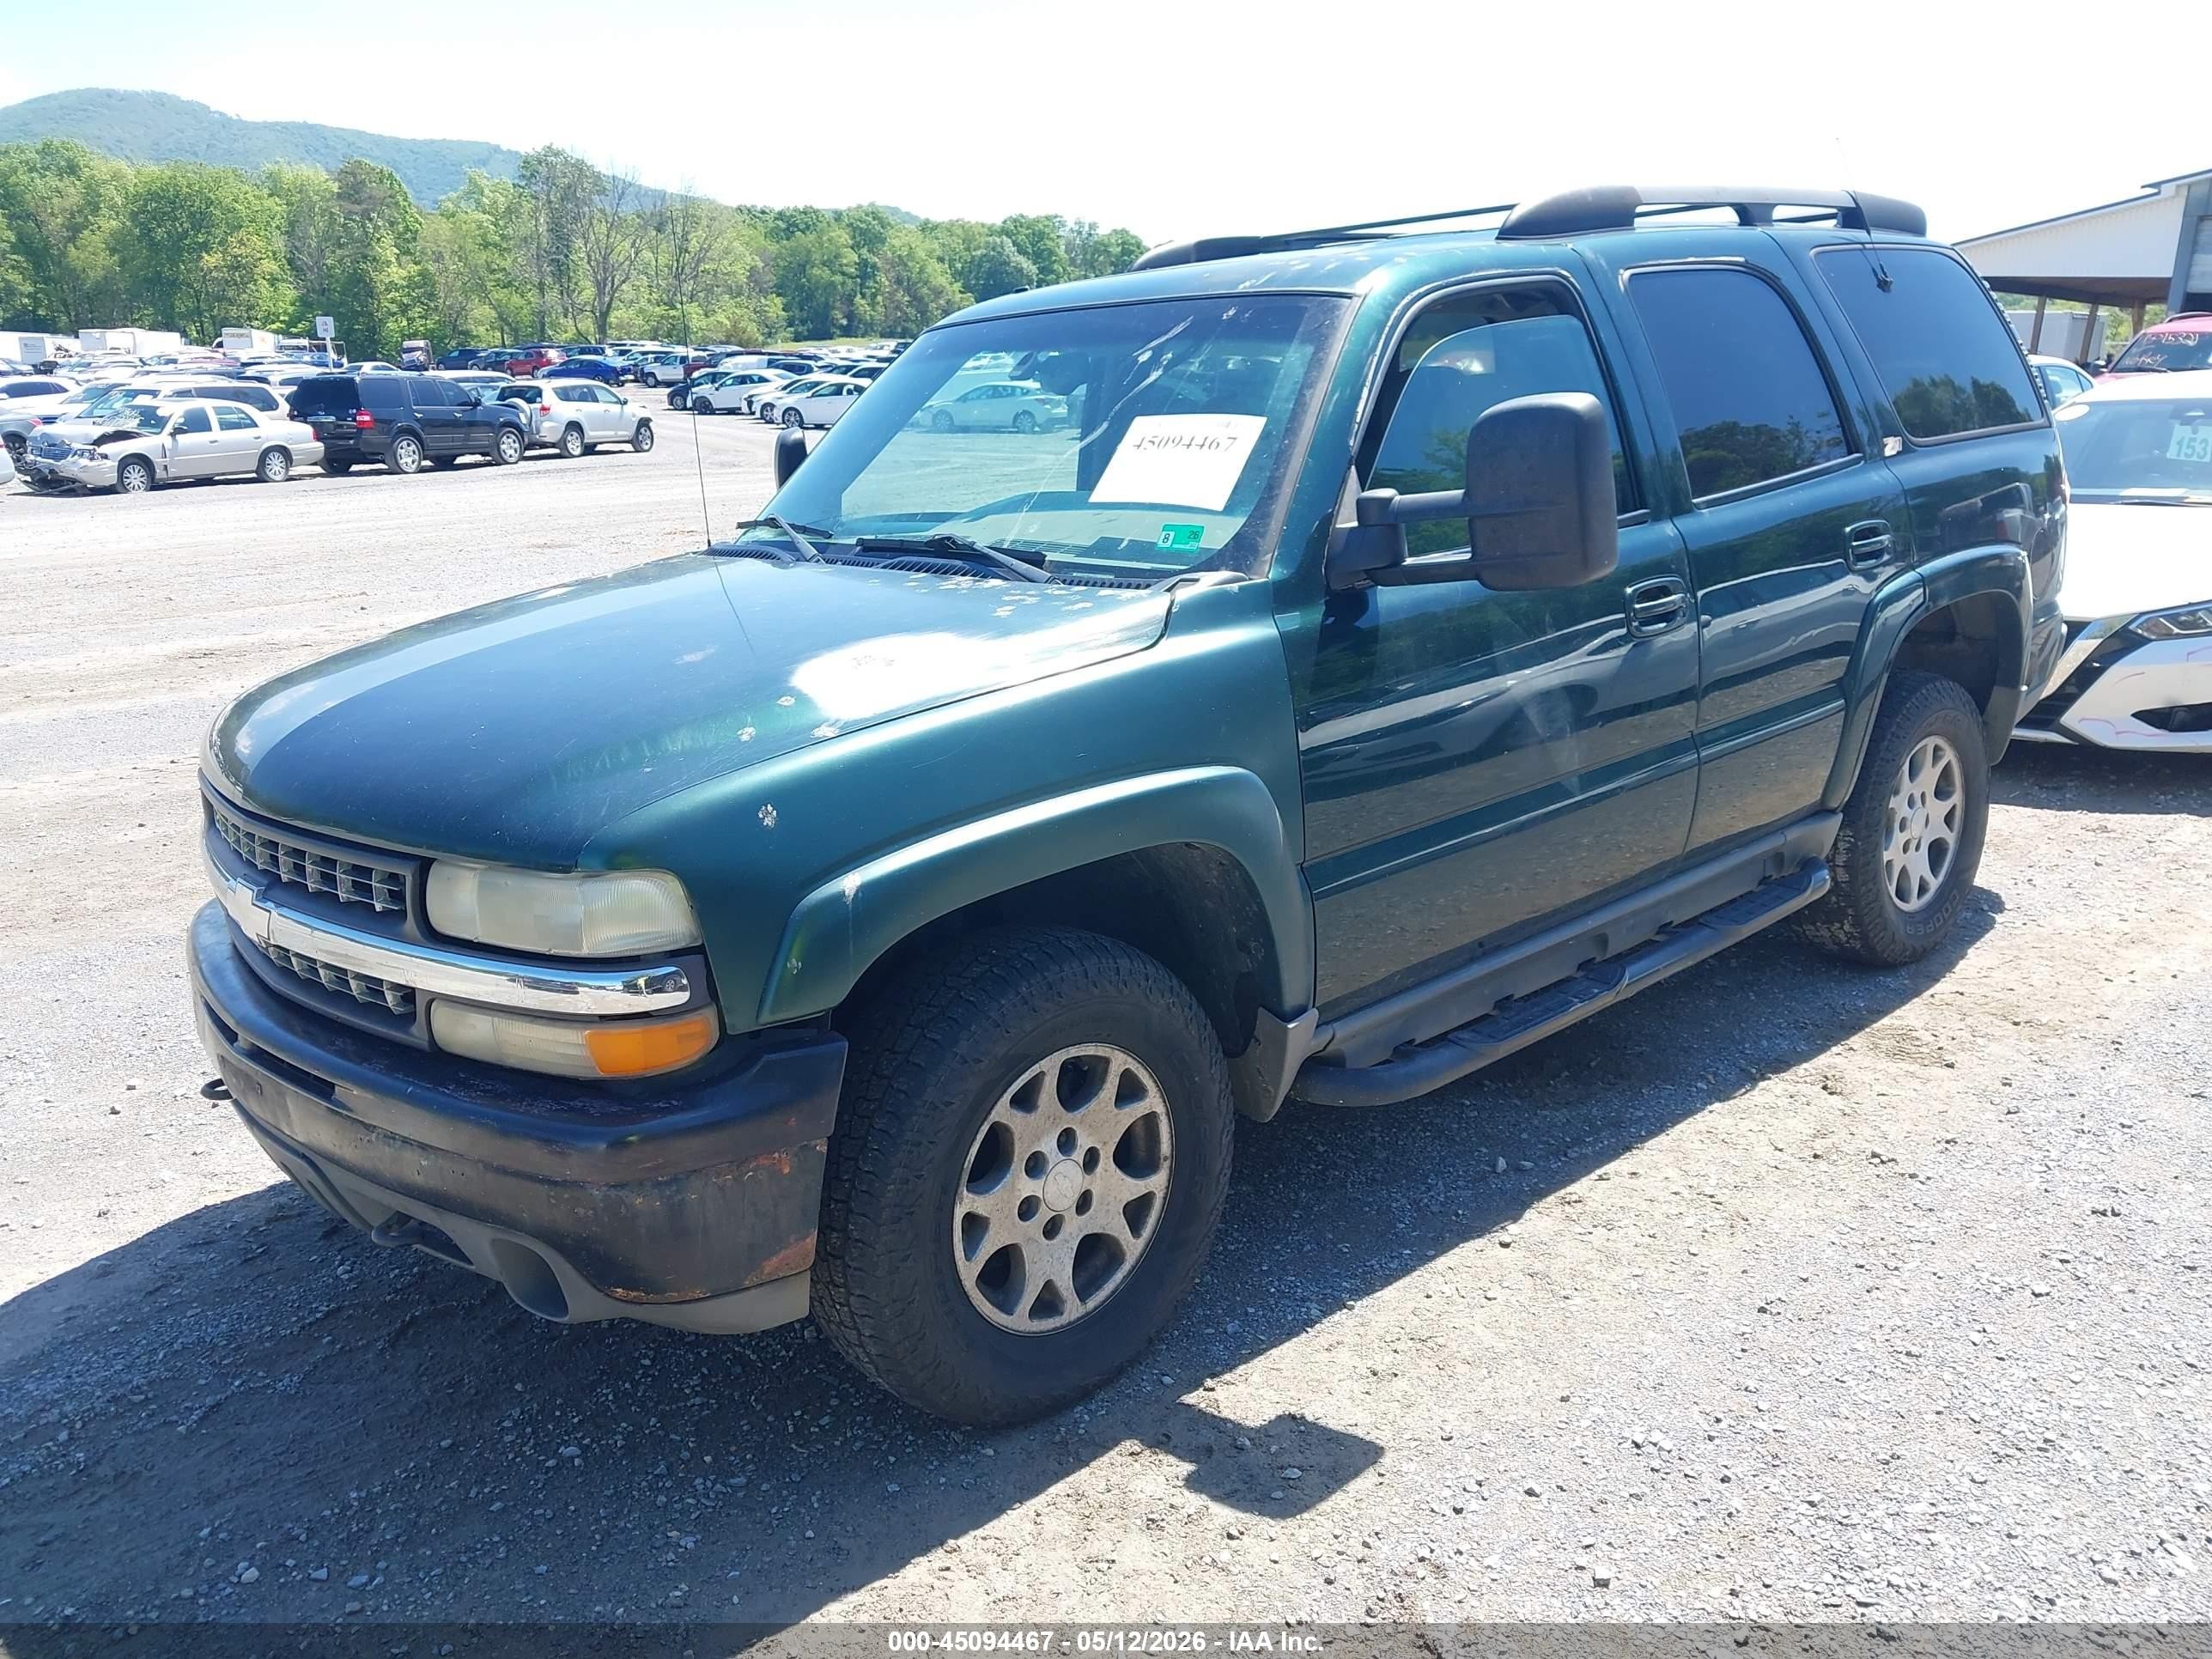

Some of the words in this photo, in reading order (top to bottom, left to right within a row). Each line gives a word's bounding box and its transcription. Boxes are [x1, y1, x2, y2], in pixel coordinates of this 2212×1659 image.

[1133, 434, 1237, 452] 45094467
[2176, 436, 2209, 460] 153
[1162, 532, 1170, 544] 8
[1187, 530, 1200, 540] 26
[1906, 888, 1960, 935] COOPER
